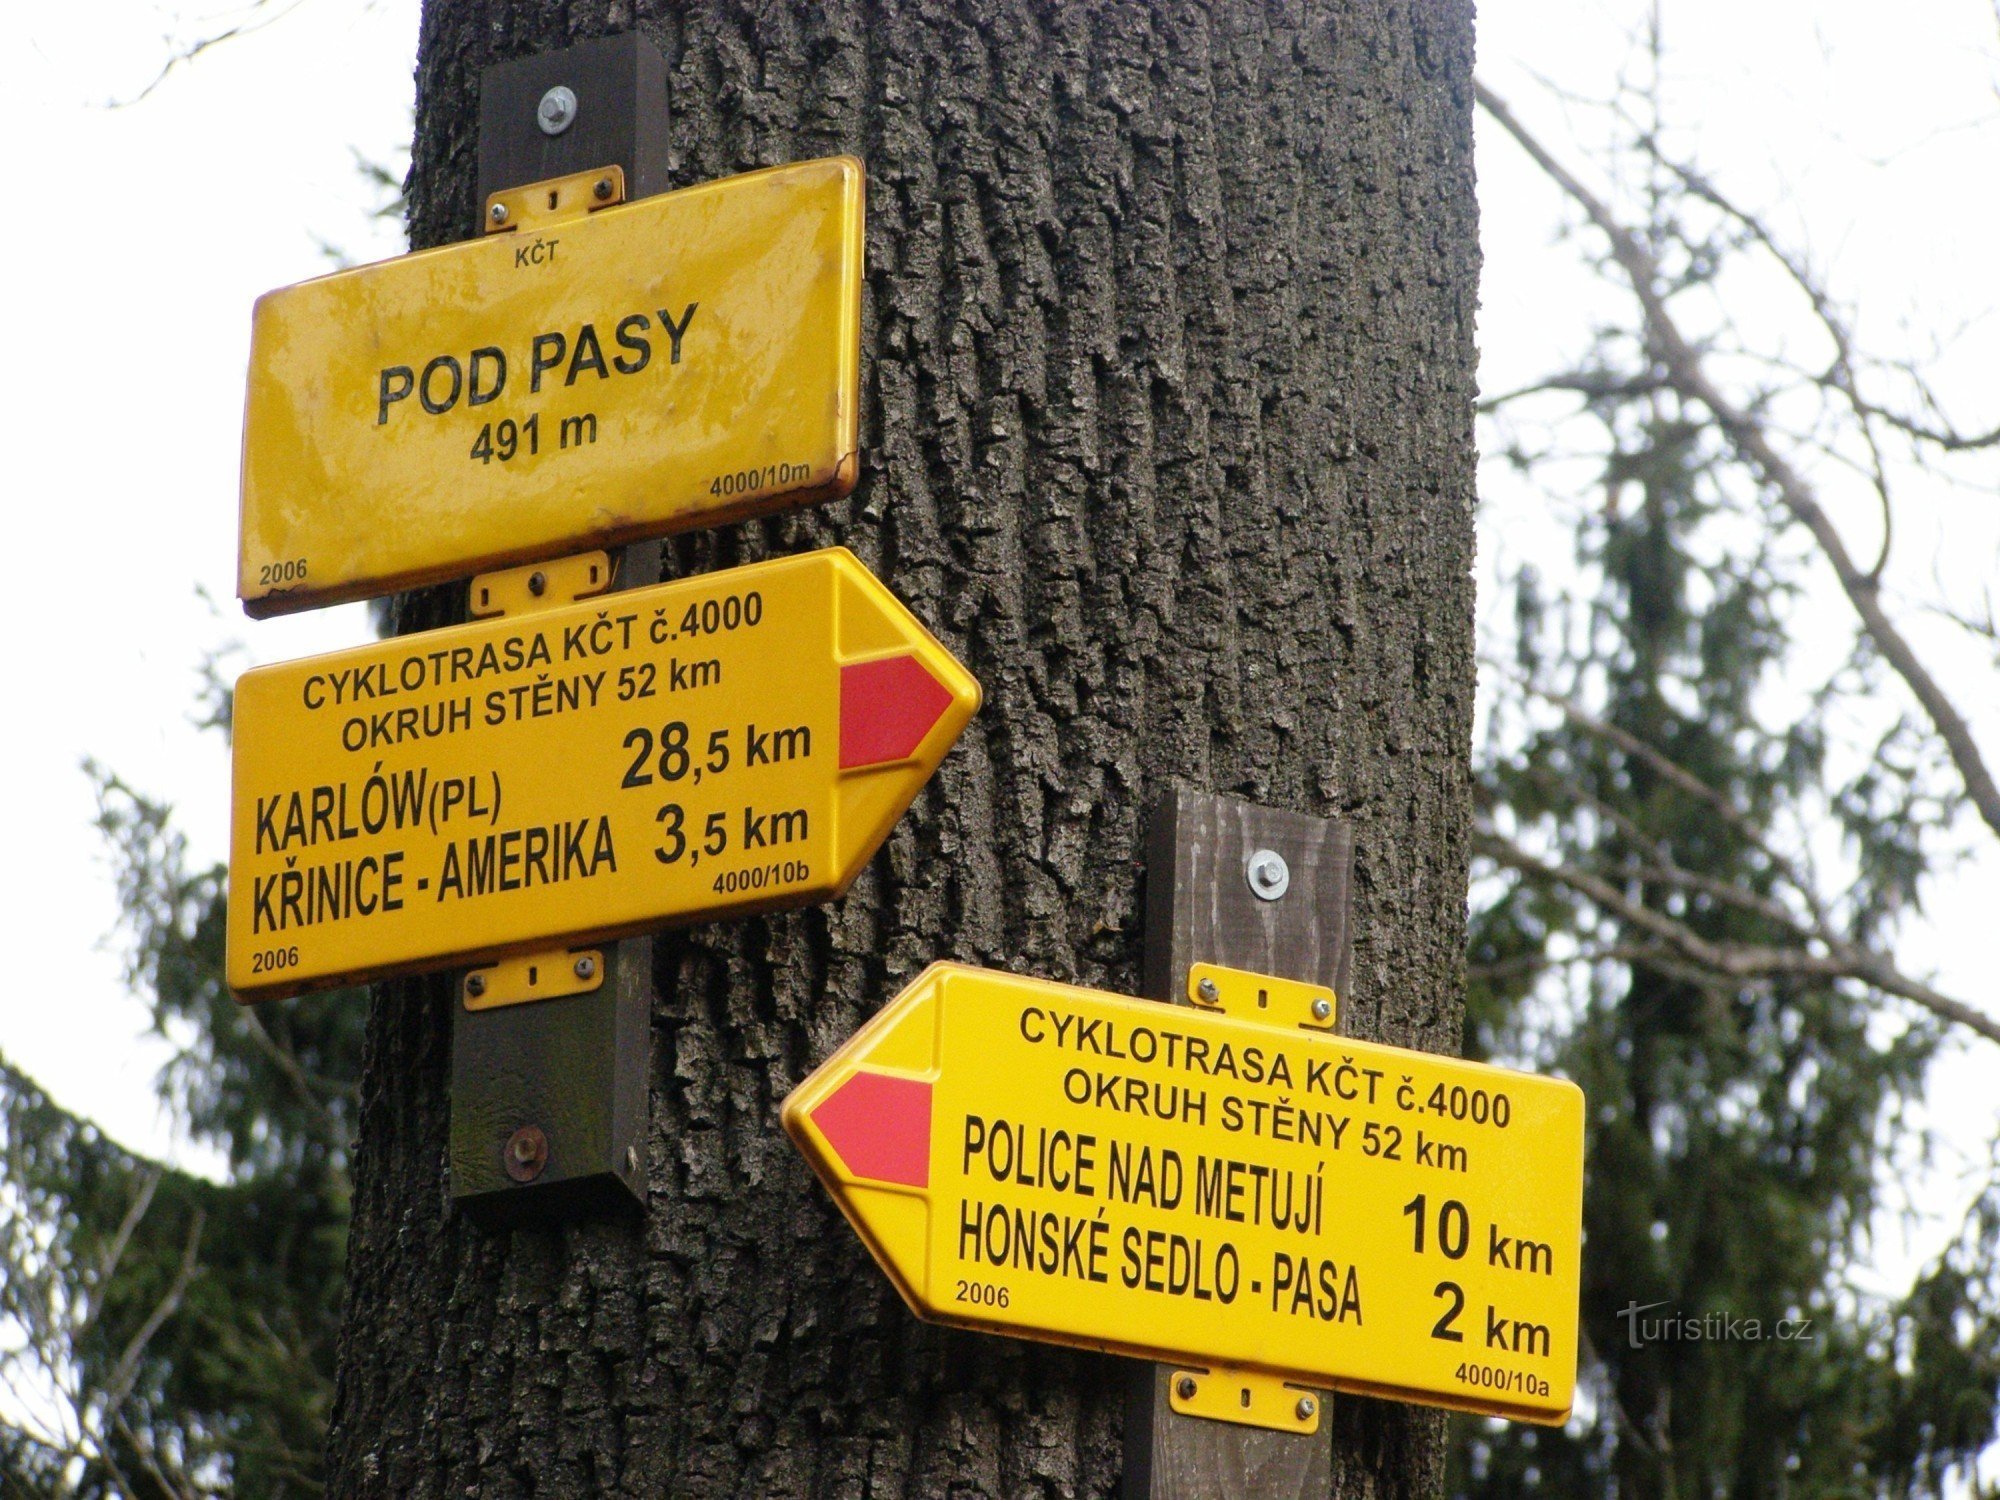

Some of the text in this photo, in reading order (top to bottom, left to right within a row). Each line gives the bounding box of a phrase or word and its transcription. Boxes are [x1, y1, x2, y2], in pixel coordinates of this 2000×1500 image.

[516, 239, 559, 268] KČT
[378, 302, 698, 425] POD PASY
[470, 413, 597, 464] 491 m
[710, 464, 809, 496] 4000/10m
[260, 559, 307, 585] 2006
[304, 592, 762, 710] CYKLOTRASA KČT č.4000
[343, 658, 720, 752] OKRUH STĚNY 52 km
[621, 721, 729, 789] 28,5
[747, 724, 810, 767] km
[254, 804, 808, 934] KŘINICE - AMERIKA 3,5 km
[713, 861, 809, 893] 4000/10b
[252, 947, 299, 973] 2006
[1020, 1008, 1510, 1128] CYKLOTRASA KČT č.4000
[1064, 1068, 1467, 1172] OKRUH STĚNY 52 km
[964, 1115, 1552, 1275] POLICE NAD METUJÍ 10 km
[957, 1280, 1008, 1308] 2006
[960, 1199, 1549, 1357] HONSKÉ SEDLO - PASA 2 km
[1456, 1363, 1548, 1396] 4000/10a
